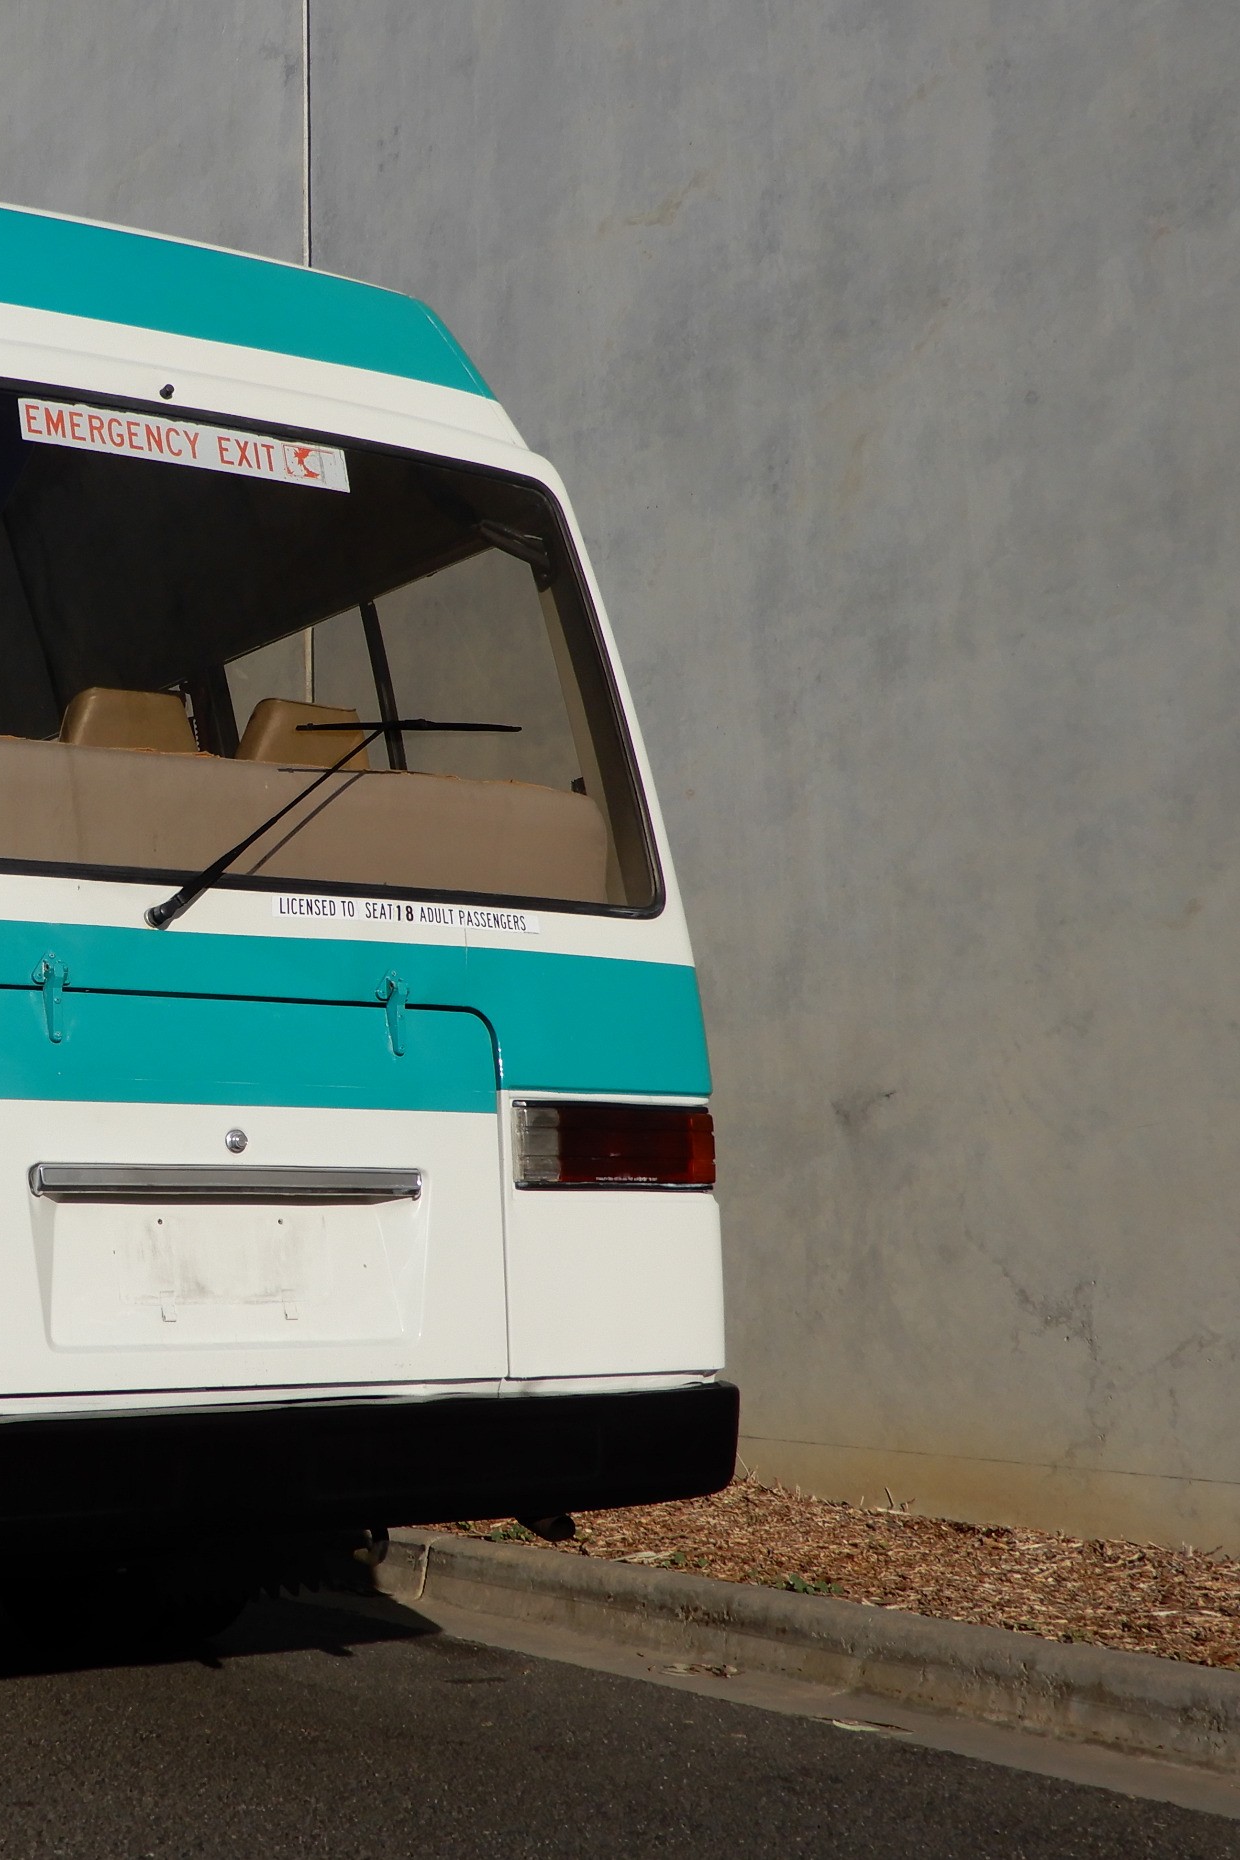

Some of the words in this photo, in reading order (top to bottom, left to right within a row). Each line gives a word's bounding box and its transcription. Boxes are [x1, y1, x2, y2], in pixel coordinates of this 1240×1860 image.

[24, 403, 200, 460] EMERGENCY
[216, 436, 275, 472] EXIT
[279, 897, 336, 916] LICENSED
[341, 900, 355, 917] TO
[365, 902, 393, 920] SEAT
[395, 904, 414, 922] 18
[419, 906, 455, 925] ADULT
[458, 909, 527, 931] PASSENGERS
